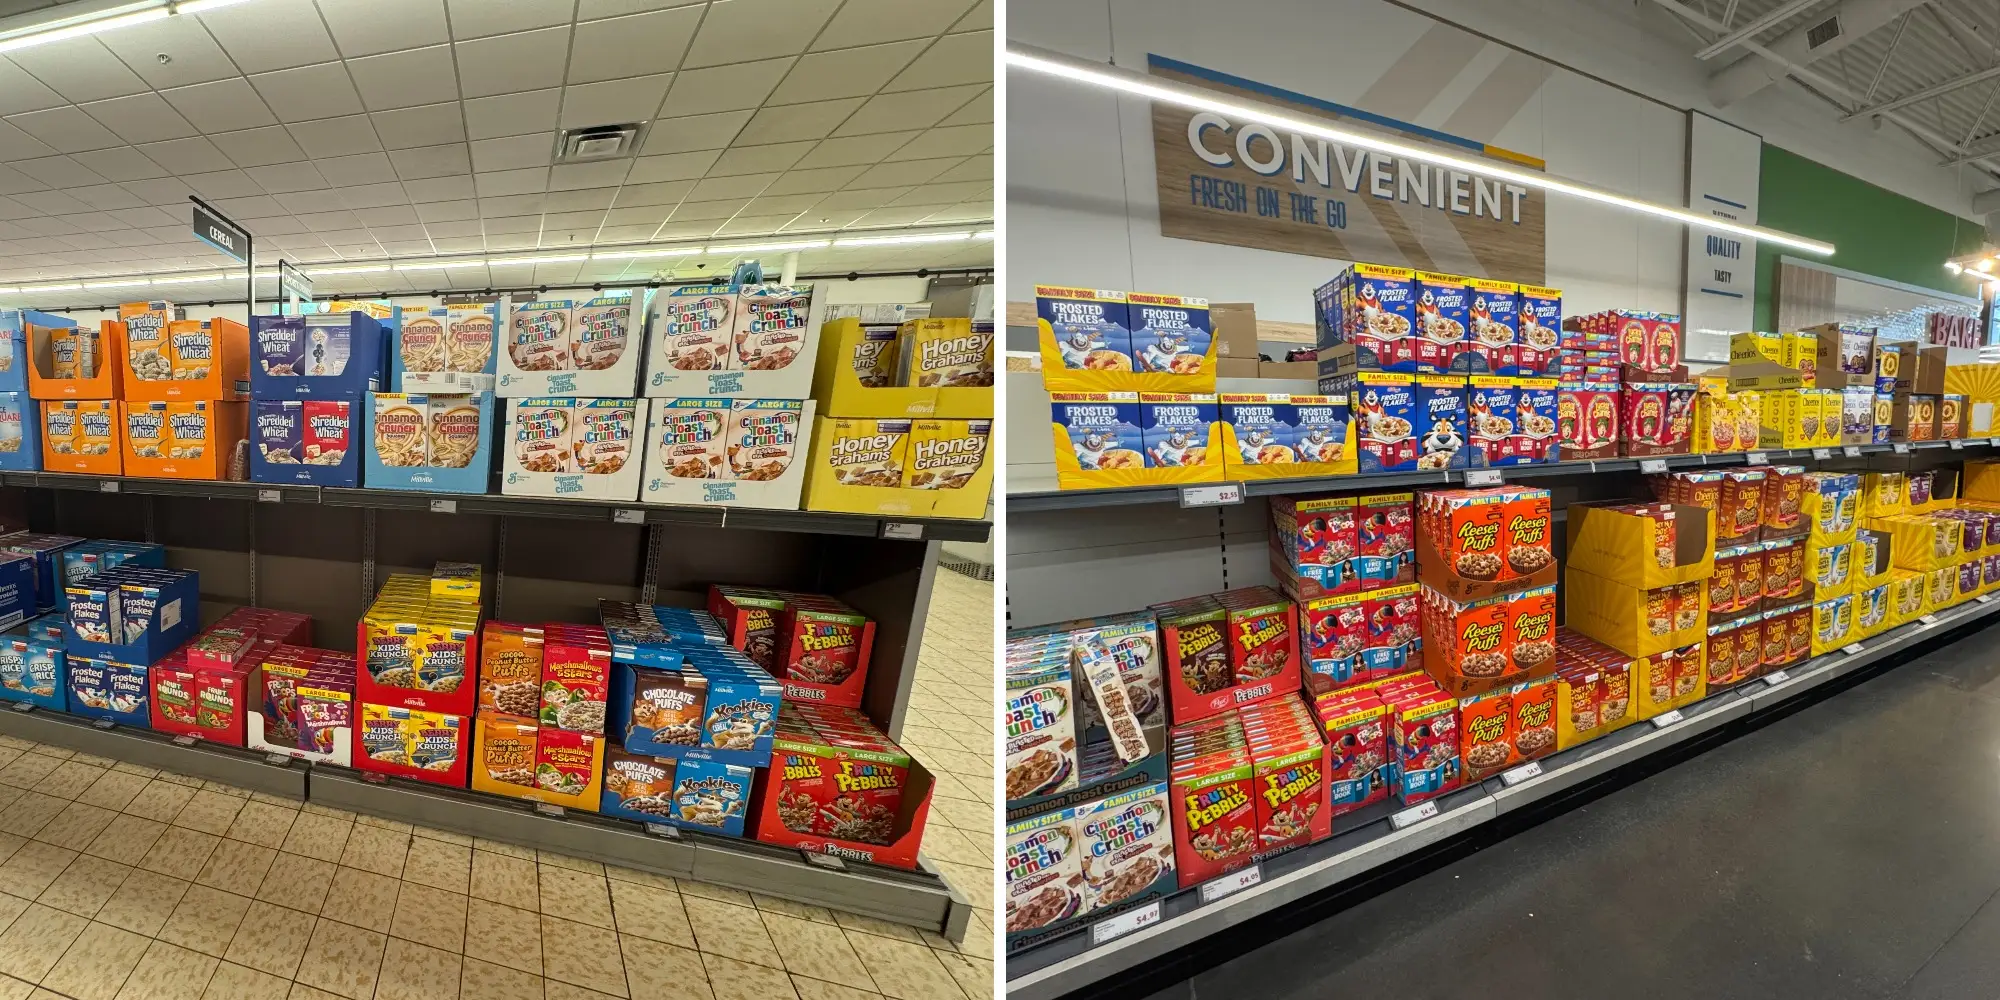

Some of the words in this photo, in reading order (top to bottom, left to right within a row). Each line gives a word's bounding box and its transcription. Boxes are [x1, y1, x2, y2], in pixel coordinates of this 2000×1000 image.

[1188, 111, 1527, 225] CONVENIENT
[1190, 175, 1247, 214] FRESH
[1256, 186, 1280, 218] ON
[1288, 192, 1318, 225] THE
[1326, 201, 1347, 230] GO
[210, 225, 233, 250] CEREAL
[1706, 234, 1741, 260] QUALITY
[1364, 265, 1391, 274] FAMILY
[1714, 268, 1732, 284] TASTY
[681, 287, 708, 295] LARGE
[711, 285, 730, 294] SIZE
[1037, 287, 1072, 299] FAMILY
[1074, 290, 1095, 299] SIZE
[1378, 288, 1408, 297] FROSTED
[1380, 294, 1405, 302] FLAKES
[667, 299, 720, 315] Cinnamon
[1052, 301, 1103, 315] FROSTED
[675, 308, 710, 323] Toast
[1057, 313, 1098, 325] FLAKES
[667, 319, 718, 335] Crunch
[258, 328, 296, 342] Shredded
[456, 332, 492, 342] CRUNCH
[180, 347, 211, 359] Wheat
[262, 342, 290, 352] Wheat
[921, 334, 994, 359] Honey
[921, 352, 984, 370] Grahams
[1730, 349, 1756, 360] Cheerios
[1778, 375, 1800, 385] Cheerios
[1428, 396, 1460, 406] FROSTED
[1802, 398, 1819, 407] Cheerios
[1066, 405, 1118, 418] FROSTED
[1430, 403, 1457, 413] FLAKES
[258, 415, 293, 428] Shredded
[310, 415, 349, 428] Shredded
[663, 411, 713, 425] Cinnamon
[740, 413, 795, 428] Cinnamon
[1072, 416, 1113, 426] FLAKES
[175, 427, 205, 439] Wheat
[262, 427, 289, 438] Wheat
[315, 428, 343, 438] Wheat
[377, 424, 416, 433] CRUNCH
[439, 424, 478, 434] CRUNCH
[671, 420, 705, 434] Toast
[749, 423, 784, 436] Toast
[663, 429, 712, 445] Crunch
[742, 431, 793, 448] Crunch
[916, 436, 986, 459] Honey
[914, 453, 981, 470] Grahams
[1219, 491, 1239, 501] $2.55
[1470, 497, 1487, 506] FAMILY
[1488, 496, 1501, 504] SIZE
[1695, 491, 1719, 502] Cheerios
[1328, 513, 1352, 526] FROOT
[1508, 515, 1547, 532] Reese's
[1332, 520, 1355, 533] LOOPS
[1458, 521, 1500, 539] Reese's
[1513, 527, 1544, 544] Puffs
[1462, 535, 1496, 553] Puffs
[70, 602, 103, 611] Frosted
[1249, 608, 1265, 617] LARGE
[1266, 605, 1279, 613] SIZE
[74, 610, 100, 619] Flakes
[1099, 628, 1128, 639] FAMILY
[1129, 625, 1146, 635] SIZE
[1178, 623, 1214, 646] COCOA
[1240, 622, 1287, 652] PEBBLES
[1463, 621, 1504, 640] Reese's
[372, 636, 407, 645] BERRY
[799, 634, 854, 652] PEBBLES
[1178, 632, 1222, 659] PEBBLES
[1467, 634, 1501, 652] Puffs
[1712, 641, 1734, 653] Cheerios
[369, 650, 408, 659] KRUNCH
[486, 657, 514, 665] Peanut
[516, 656, 538, 664] Butter
[2, 664, 22, 673] RICE
[71, 668, 103, 678] Frosted
[492, 664, 529, 677] Puffs
[549, 661, 602, 673] Marshmallows
[75, 676, 100, 685] Flakes
[207, 686, 227, 696] FRUIT
[642, 689, 696, 704] CHOCOLATE
[715, 686, 734, 694] Millville
[785, 684, 826, 700] PEBBLES
[1233, 683, 1273, 703] PEBBLES
[200, 691, 234, 706] ROUNDS
[655, 698, 683, 710] PUFFS
[301, 704, 329, 714] FROOT
[713, 699, 773, 718] Kookies
[1412, 707, 1437, 717] FAMILY
[1438, 702, 1452, 710] SIZE
[304, 712, 330, 720] LOOPS
[306, 720, 347, 728] Marshmallows
[685, 751, 712, 760] Millville
[854, 752, 875, 760] LARGE
[877, 754, 894, 763] SIZE
[1276, 757, 1298, 768] LARGE
[1299, 753, 1312, 761] SIZE
[835, 773, 898, 793] PEBBLES
[1262, 768, 1322, 809] PEBBLES
[1006, 798, 1069, 821] innamon
[1067, 787, 1102, 805] Toast
[1103, 772, 1149, 797] Crunch
[1103, 795, 1134, 809] FAMILY
[1136, 788, 1157, 799] SIZE
[1084, 801, 1154, 837] Cinnamon
[1099, 818, 1144, 842] Toast
[1091, 825, 1156, 858] Crunch
[1240, 872, 1259, 886] $4.05
[1136, 909, 1158, 925] $4.97
